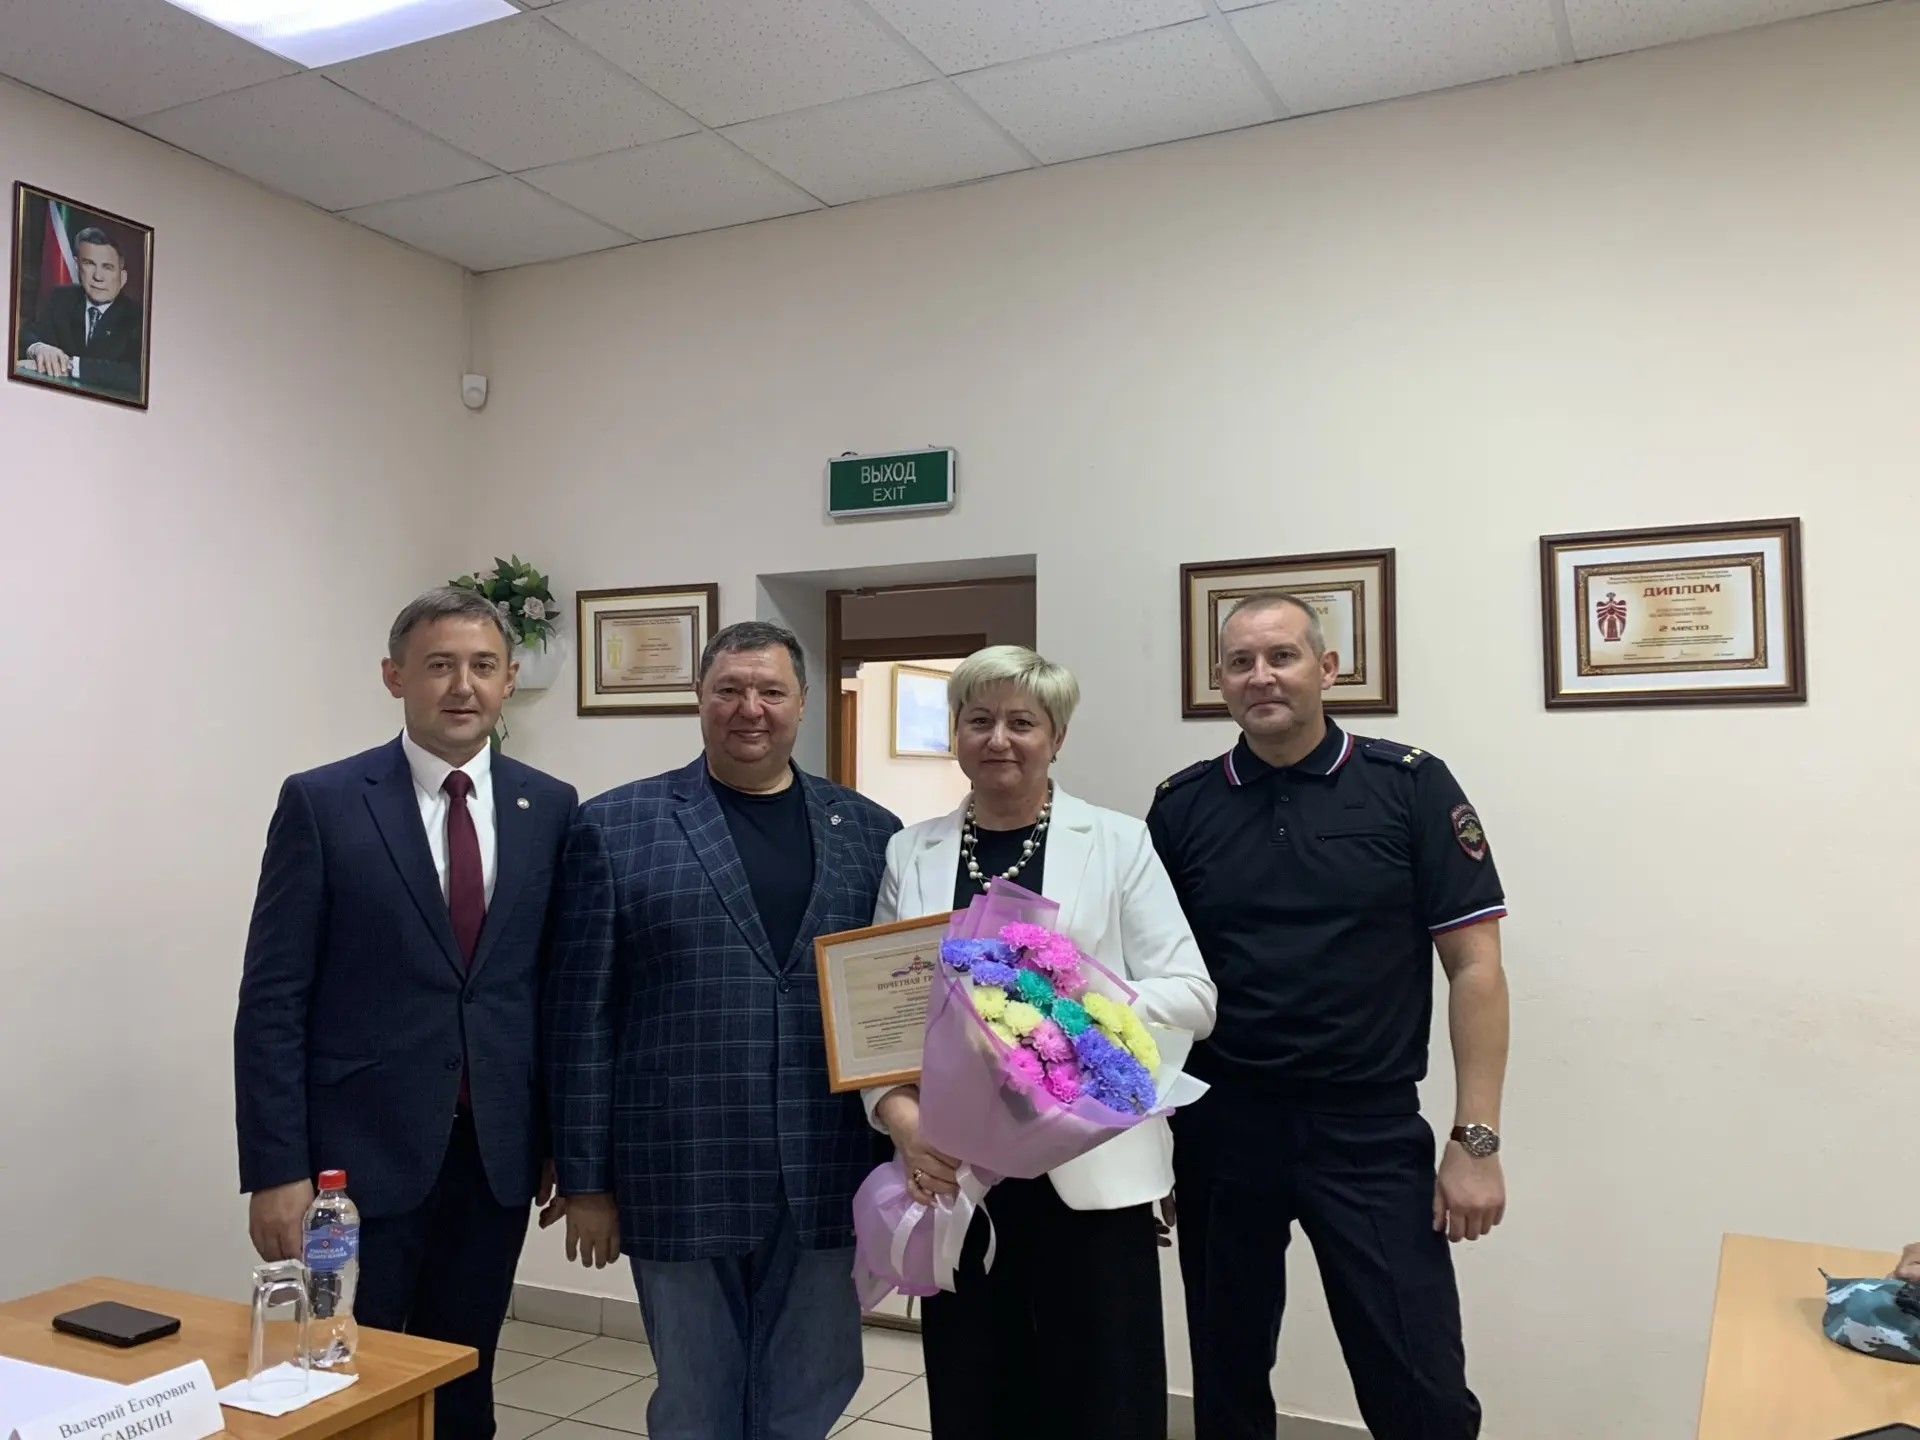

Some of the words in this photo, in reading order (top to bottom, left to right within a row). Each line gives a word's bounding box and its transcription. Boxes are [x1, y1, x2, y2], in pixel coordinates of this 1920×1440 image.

[861, 462, 916, 484] ВЫХОД
[873, 486, 906, 501] EXIT
[1643, 583, 1721, 597] ДИПЛОМ
[59, 1403, 126, 1439] Валерий
[127, 1380, 196, 1413] Егорович
